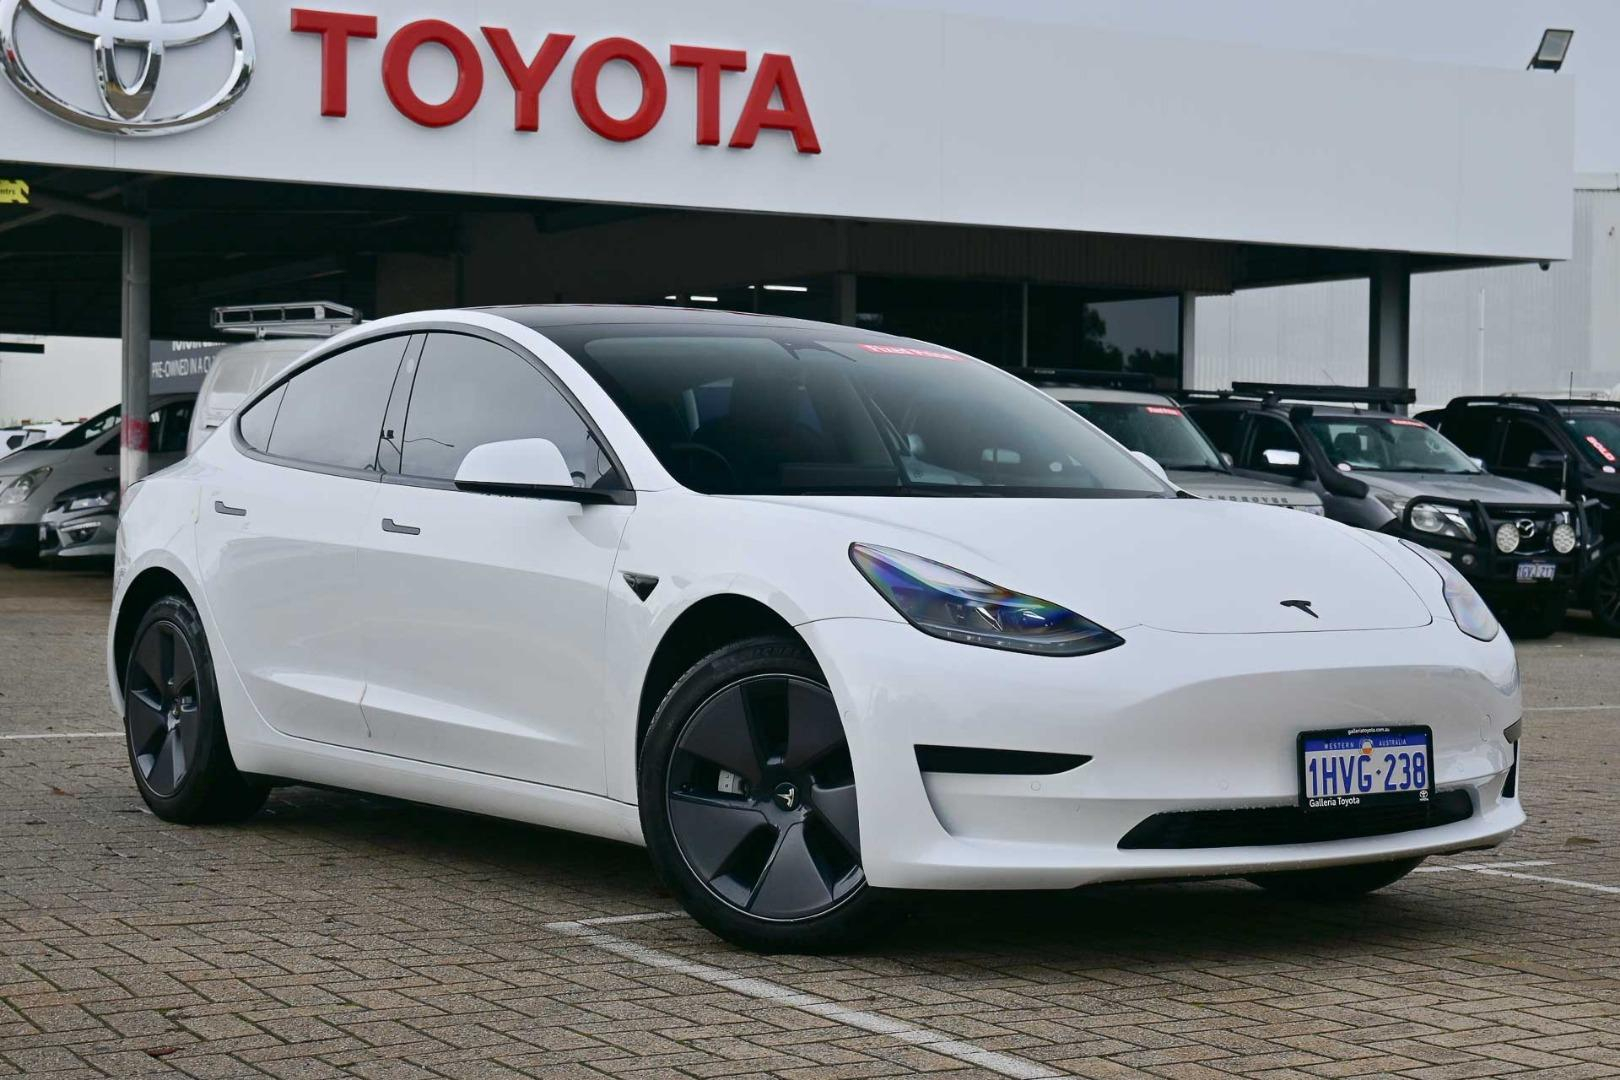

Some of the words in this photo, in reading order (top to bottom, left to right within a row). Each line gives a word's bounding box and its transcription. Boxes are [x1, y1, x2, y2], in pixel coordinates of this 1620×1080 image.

[291, 8, 821, 154] TOYOTA
[152, 358, 189, 378] PRE-OWNED
[1324, 742, 1354, 750] WESTERN
[1379, 738, 1407, 746] AUSTRALIA
[1309, 799, 1337, 808] Galleria
[1338, 797, 1360, 807] Toyota
